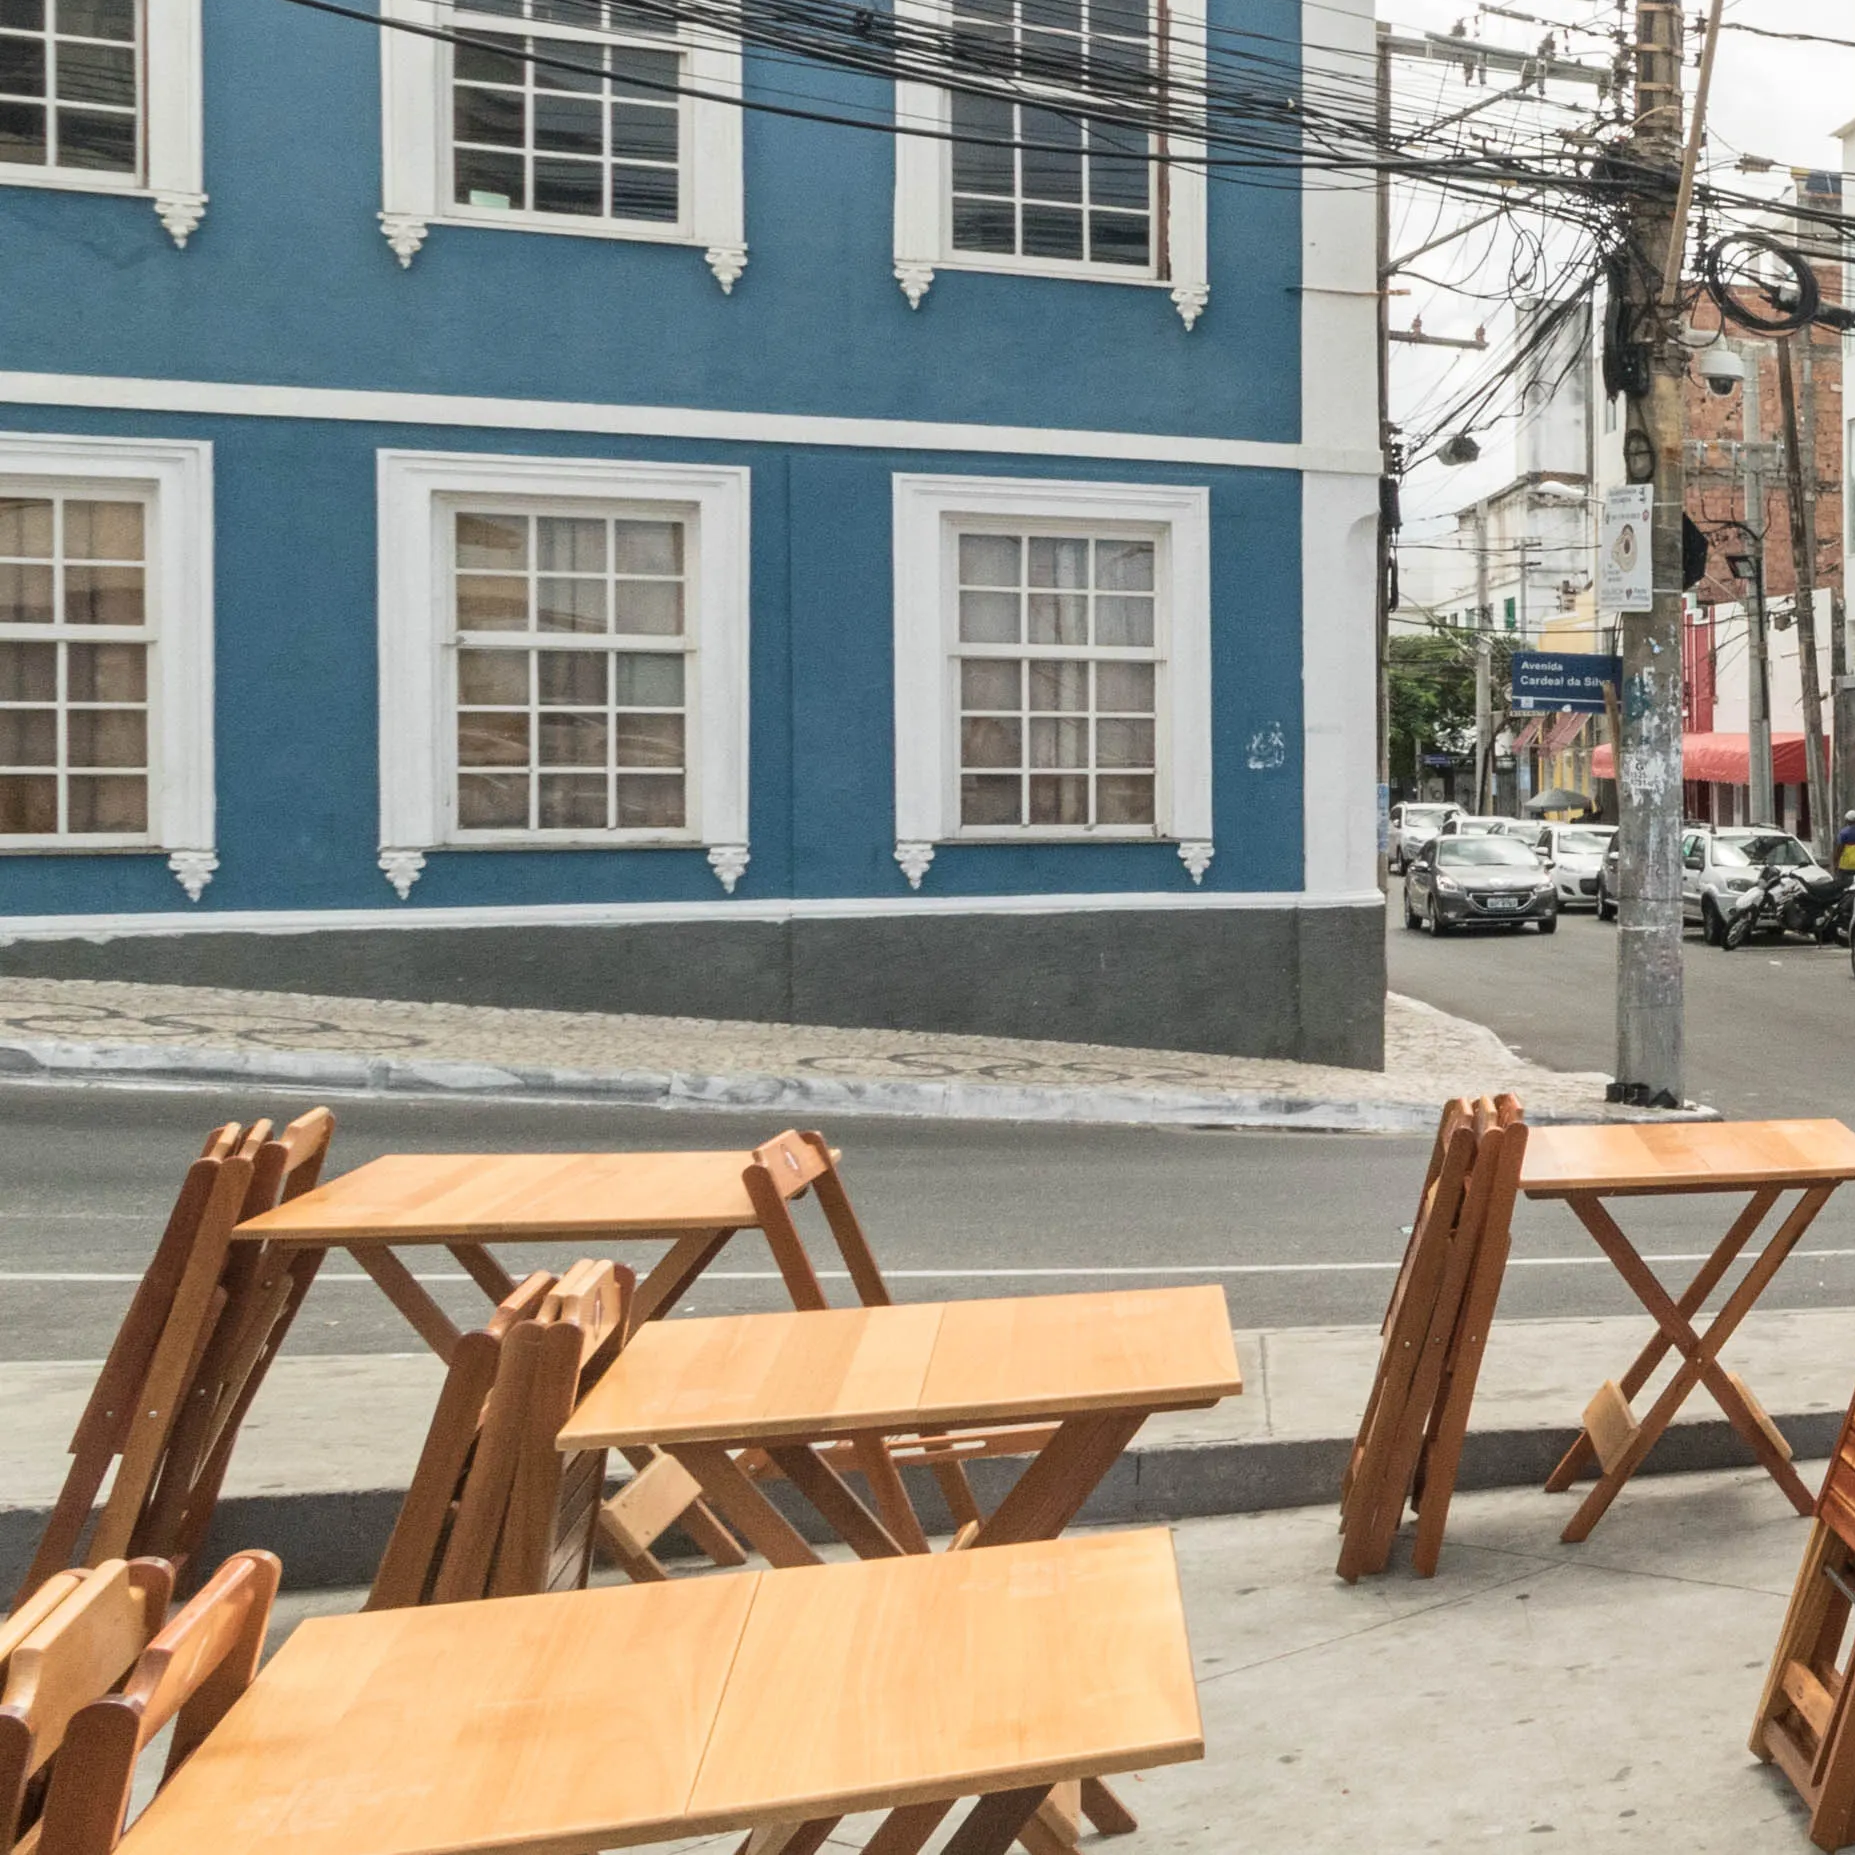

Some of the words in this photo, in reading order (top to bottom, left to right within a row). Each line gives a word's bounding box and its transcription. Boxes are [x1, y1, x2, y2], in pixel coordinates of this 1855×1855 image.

[1521, 660, 1564, 671] Avenida
[1520, 675, 1565, 686] Cardeal
[1567, 677, 1582, 686] da
